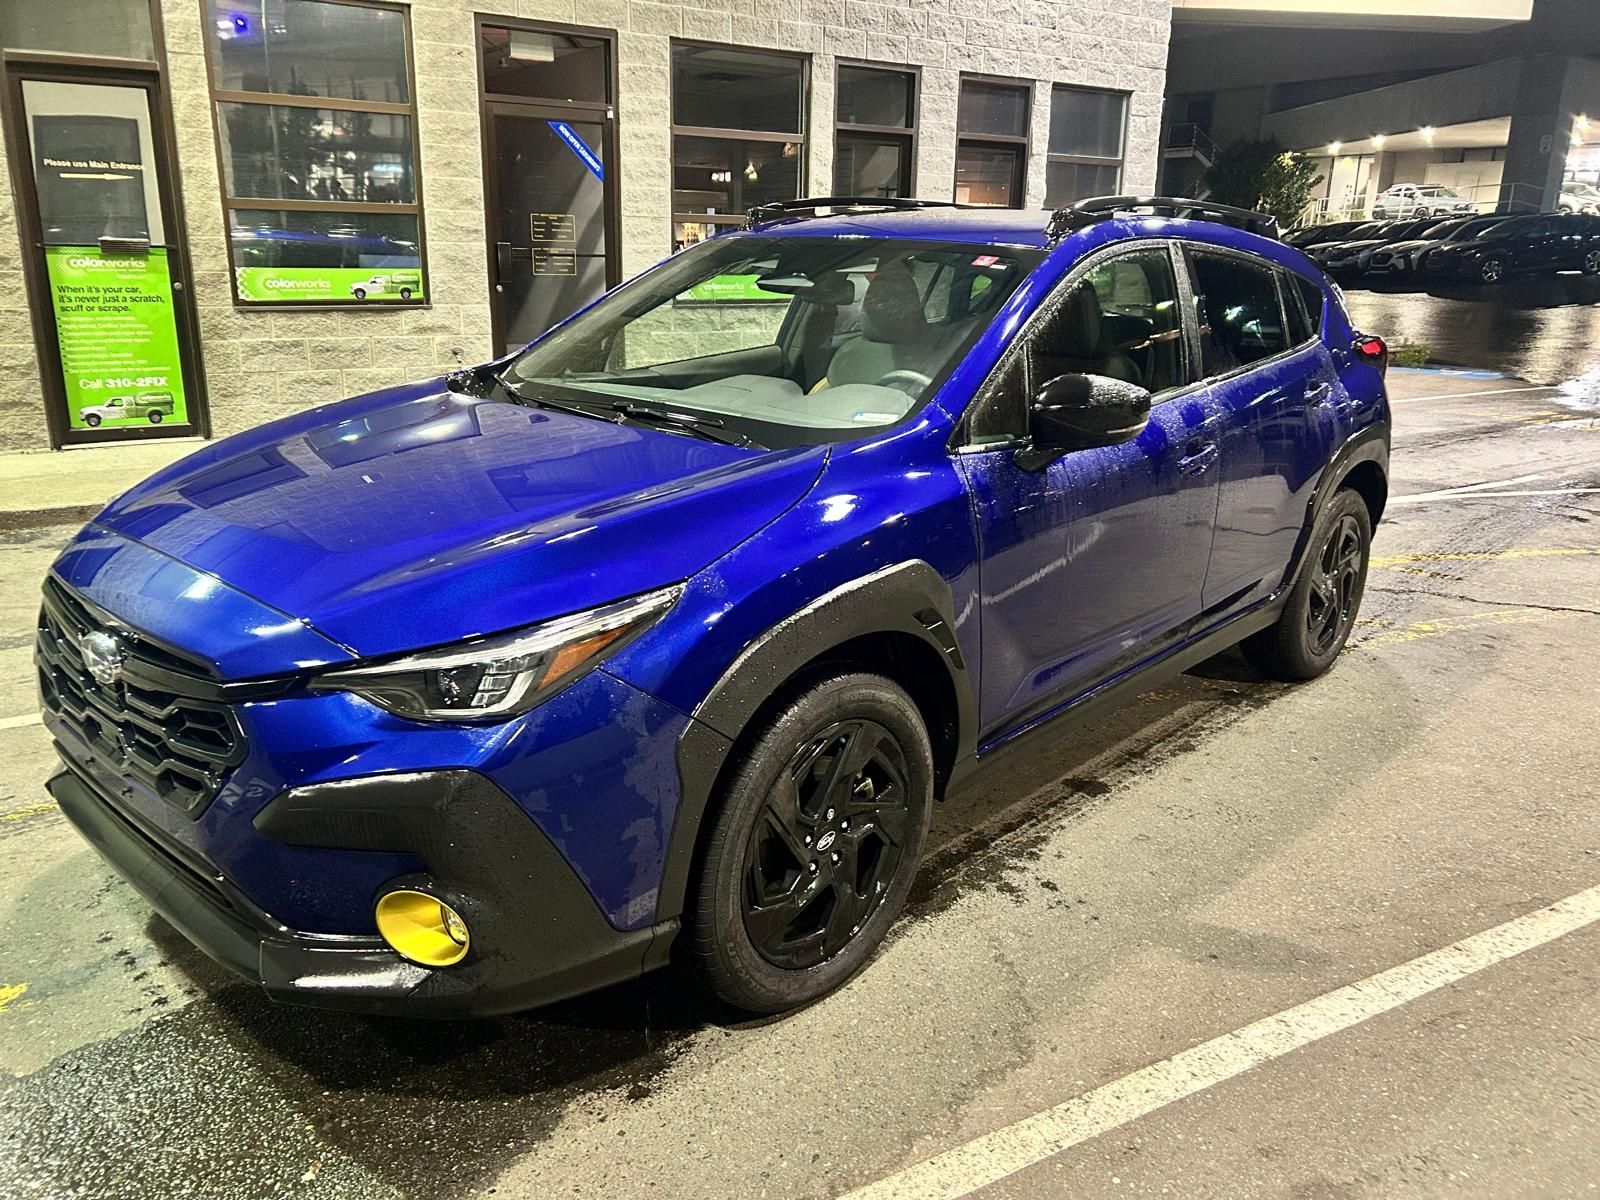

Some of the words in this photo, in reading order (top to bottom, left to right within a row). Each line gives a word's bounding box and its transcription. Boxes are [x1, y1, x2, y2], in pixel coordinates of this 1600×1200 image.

[558, 124, 571, 138] NOW
[568, 135, 581, 149] OPEN
[43, 158, 71, 167] Please
[89, 160, 109, 168] Main
[69, 257, 146, 268] colorworks
[265, 278, 332, 288] colorworks
[57, 285, 84, 293] When
[86, 285, 101, 293] it's
[103, 286, 123, 294] your
[125, 286, 142, 294] car,
[58, 294, 73, 303] it's
[74, 295, 100, 303] never
[102, 294, 120, 304] just
[129, 294, 165, 304] scratch,
[60, 304, 84, 312] scuff
[98, 304, 132, 313] scrape.
[79, 378, 103, 389] Call
[106, 376, 169, 388] 310-2FIX
